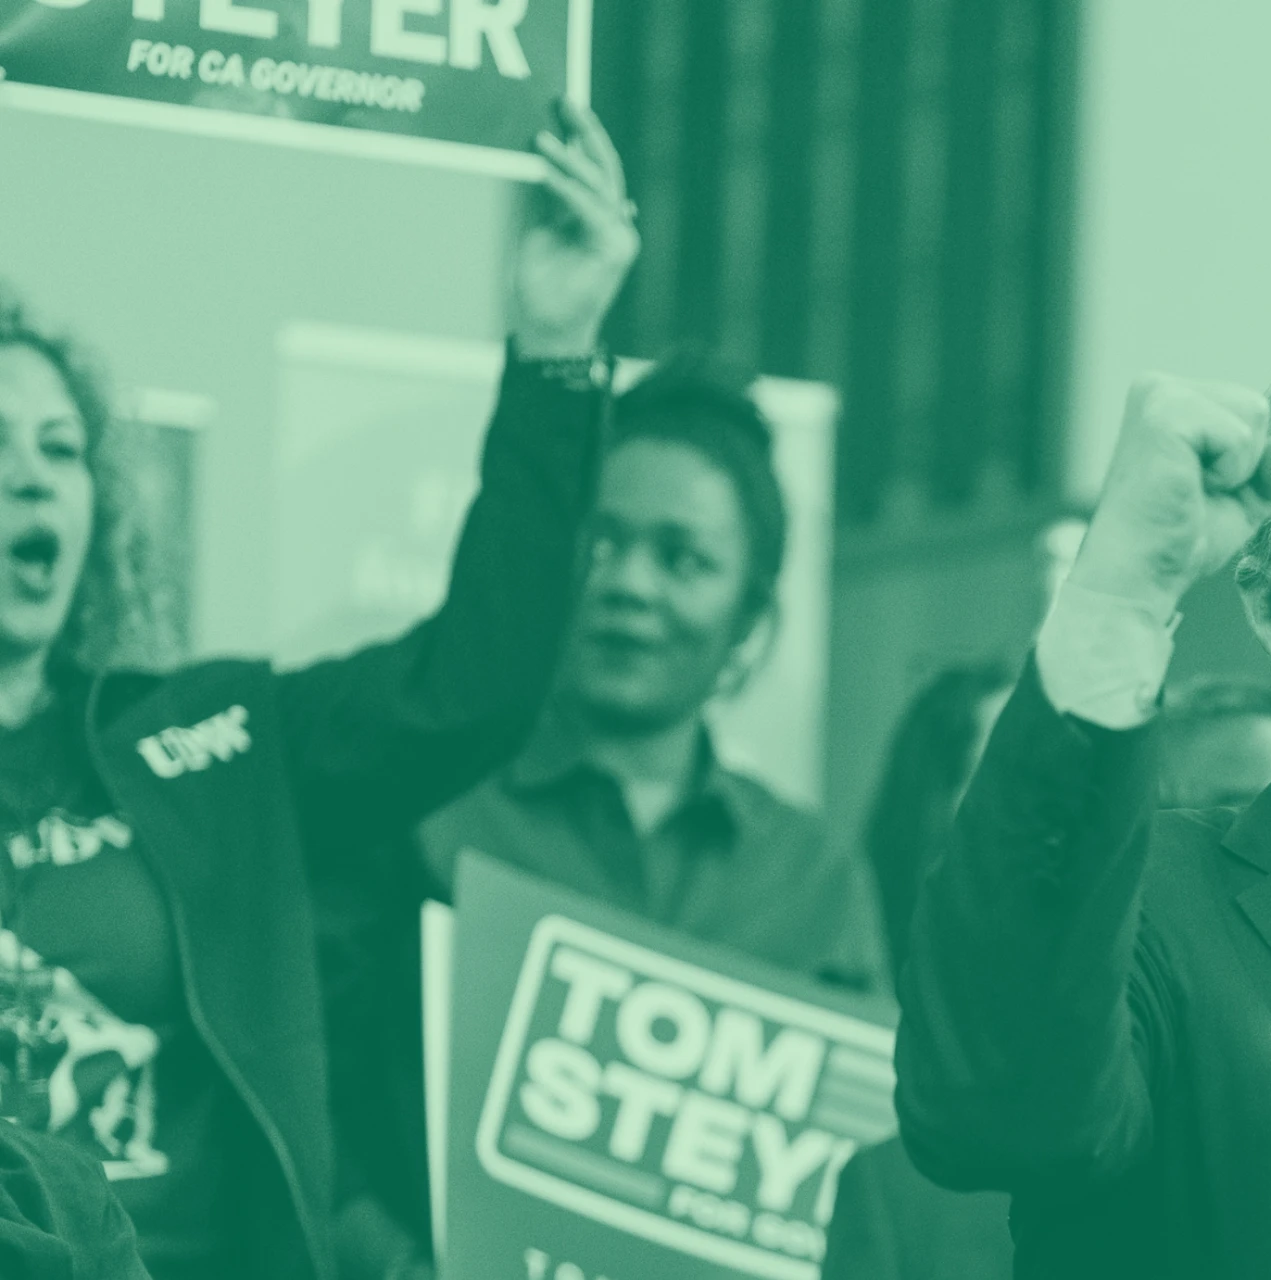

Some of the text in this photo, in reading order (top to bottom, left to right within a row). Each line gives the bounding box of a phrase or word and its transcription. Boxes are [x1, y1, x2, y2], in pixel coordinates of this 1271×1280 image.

[127, 39, 426, 112] FOR CA GOVERNOR
[550, 944, 827, 1122] TOM
